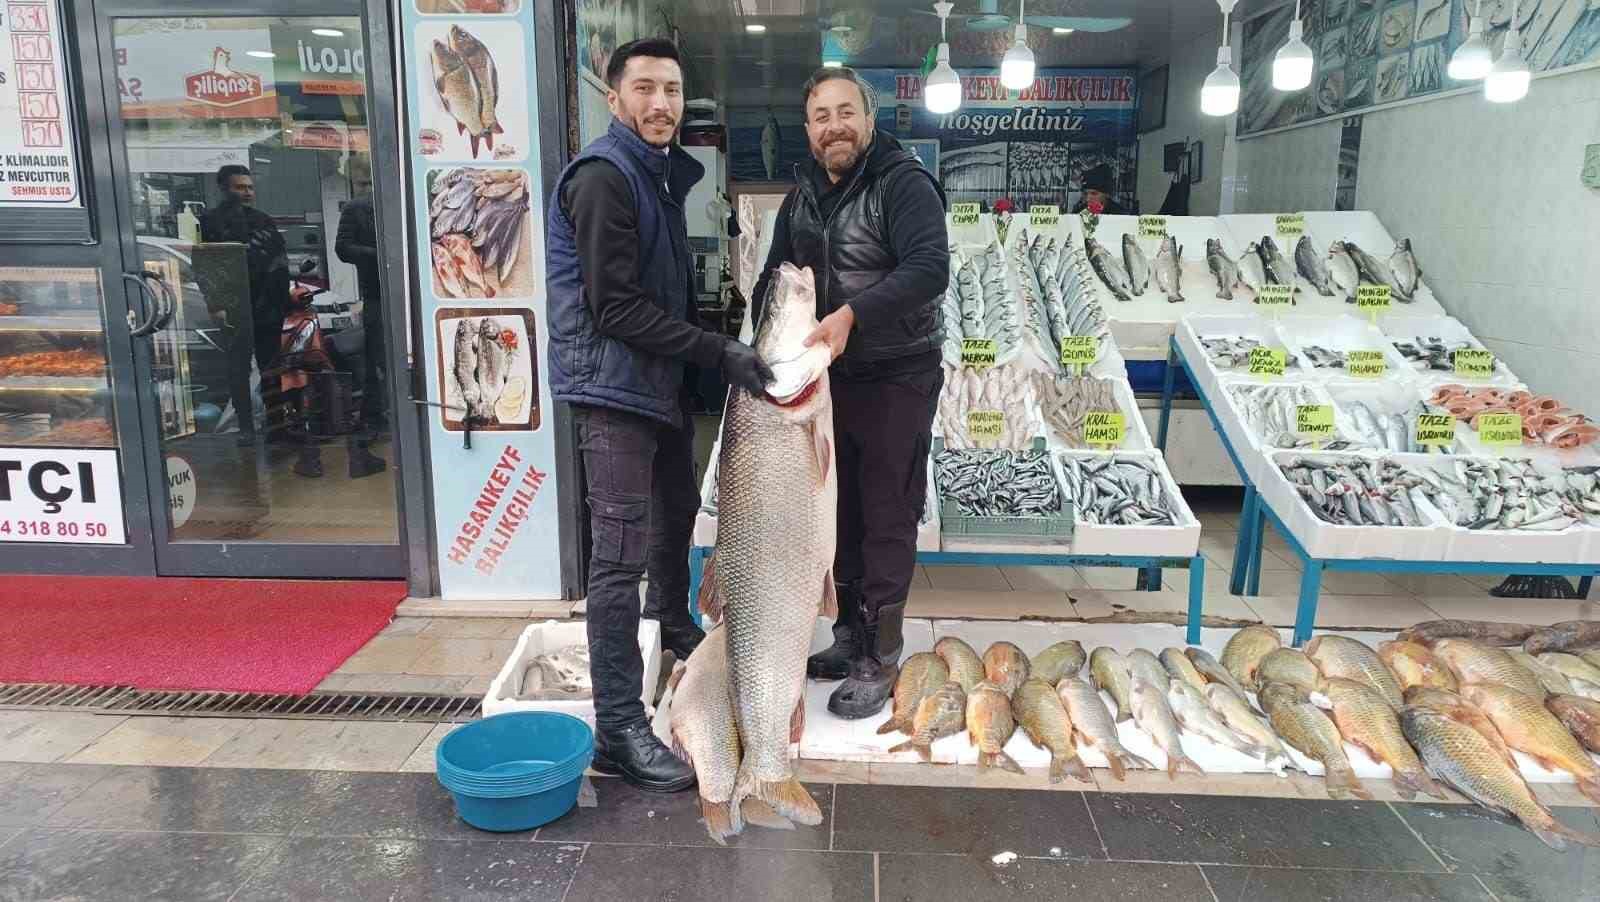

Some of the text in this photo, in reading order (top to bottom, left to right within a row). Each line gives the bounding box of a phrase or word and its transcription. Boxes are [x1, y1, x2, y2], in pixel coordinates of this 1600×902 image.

[20, 64, 54, 89] 150
[22, 94, 58, 118] 150
[24, 122, 62, 146] 150
[8, 171, 70, 182] MEVCUTTUR
[50, 186, 71, 196] USTA
[963, 340, 992, 350] TAZE
[1063, 337, 1091, 346] TAZE
[1297, 405, 1320, 413] TAZE
[1420, 415, 1451, 425] TAZE
[1484, 416, 1512, 425] TAZE
[0, 460, 96, 514] TÇI
[448, 445, 521, 565] HASANKEYF
[475, 465, 547, 575] BALIKÇILIK
[18, 520, 49, 536] 318
[57, 522, 78, 537] 80
[85, 522, 107, 537] 50
